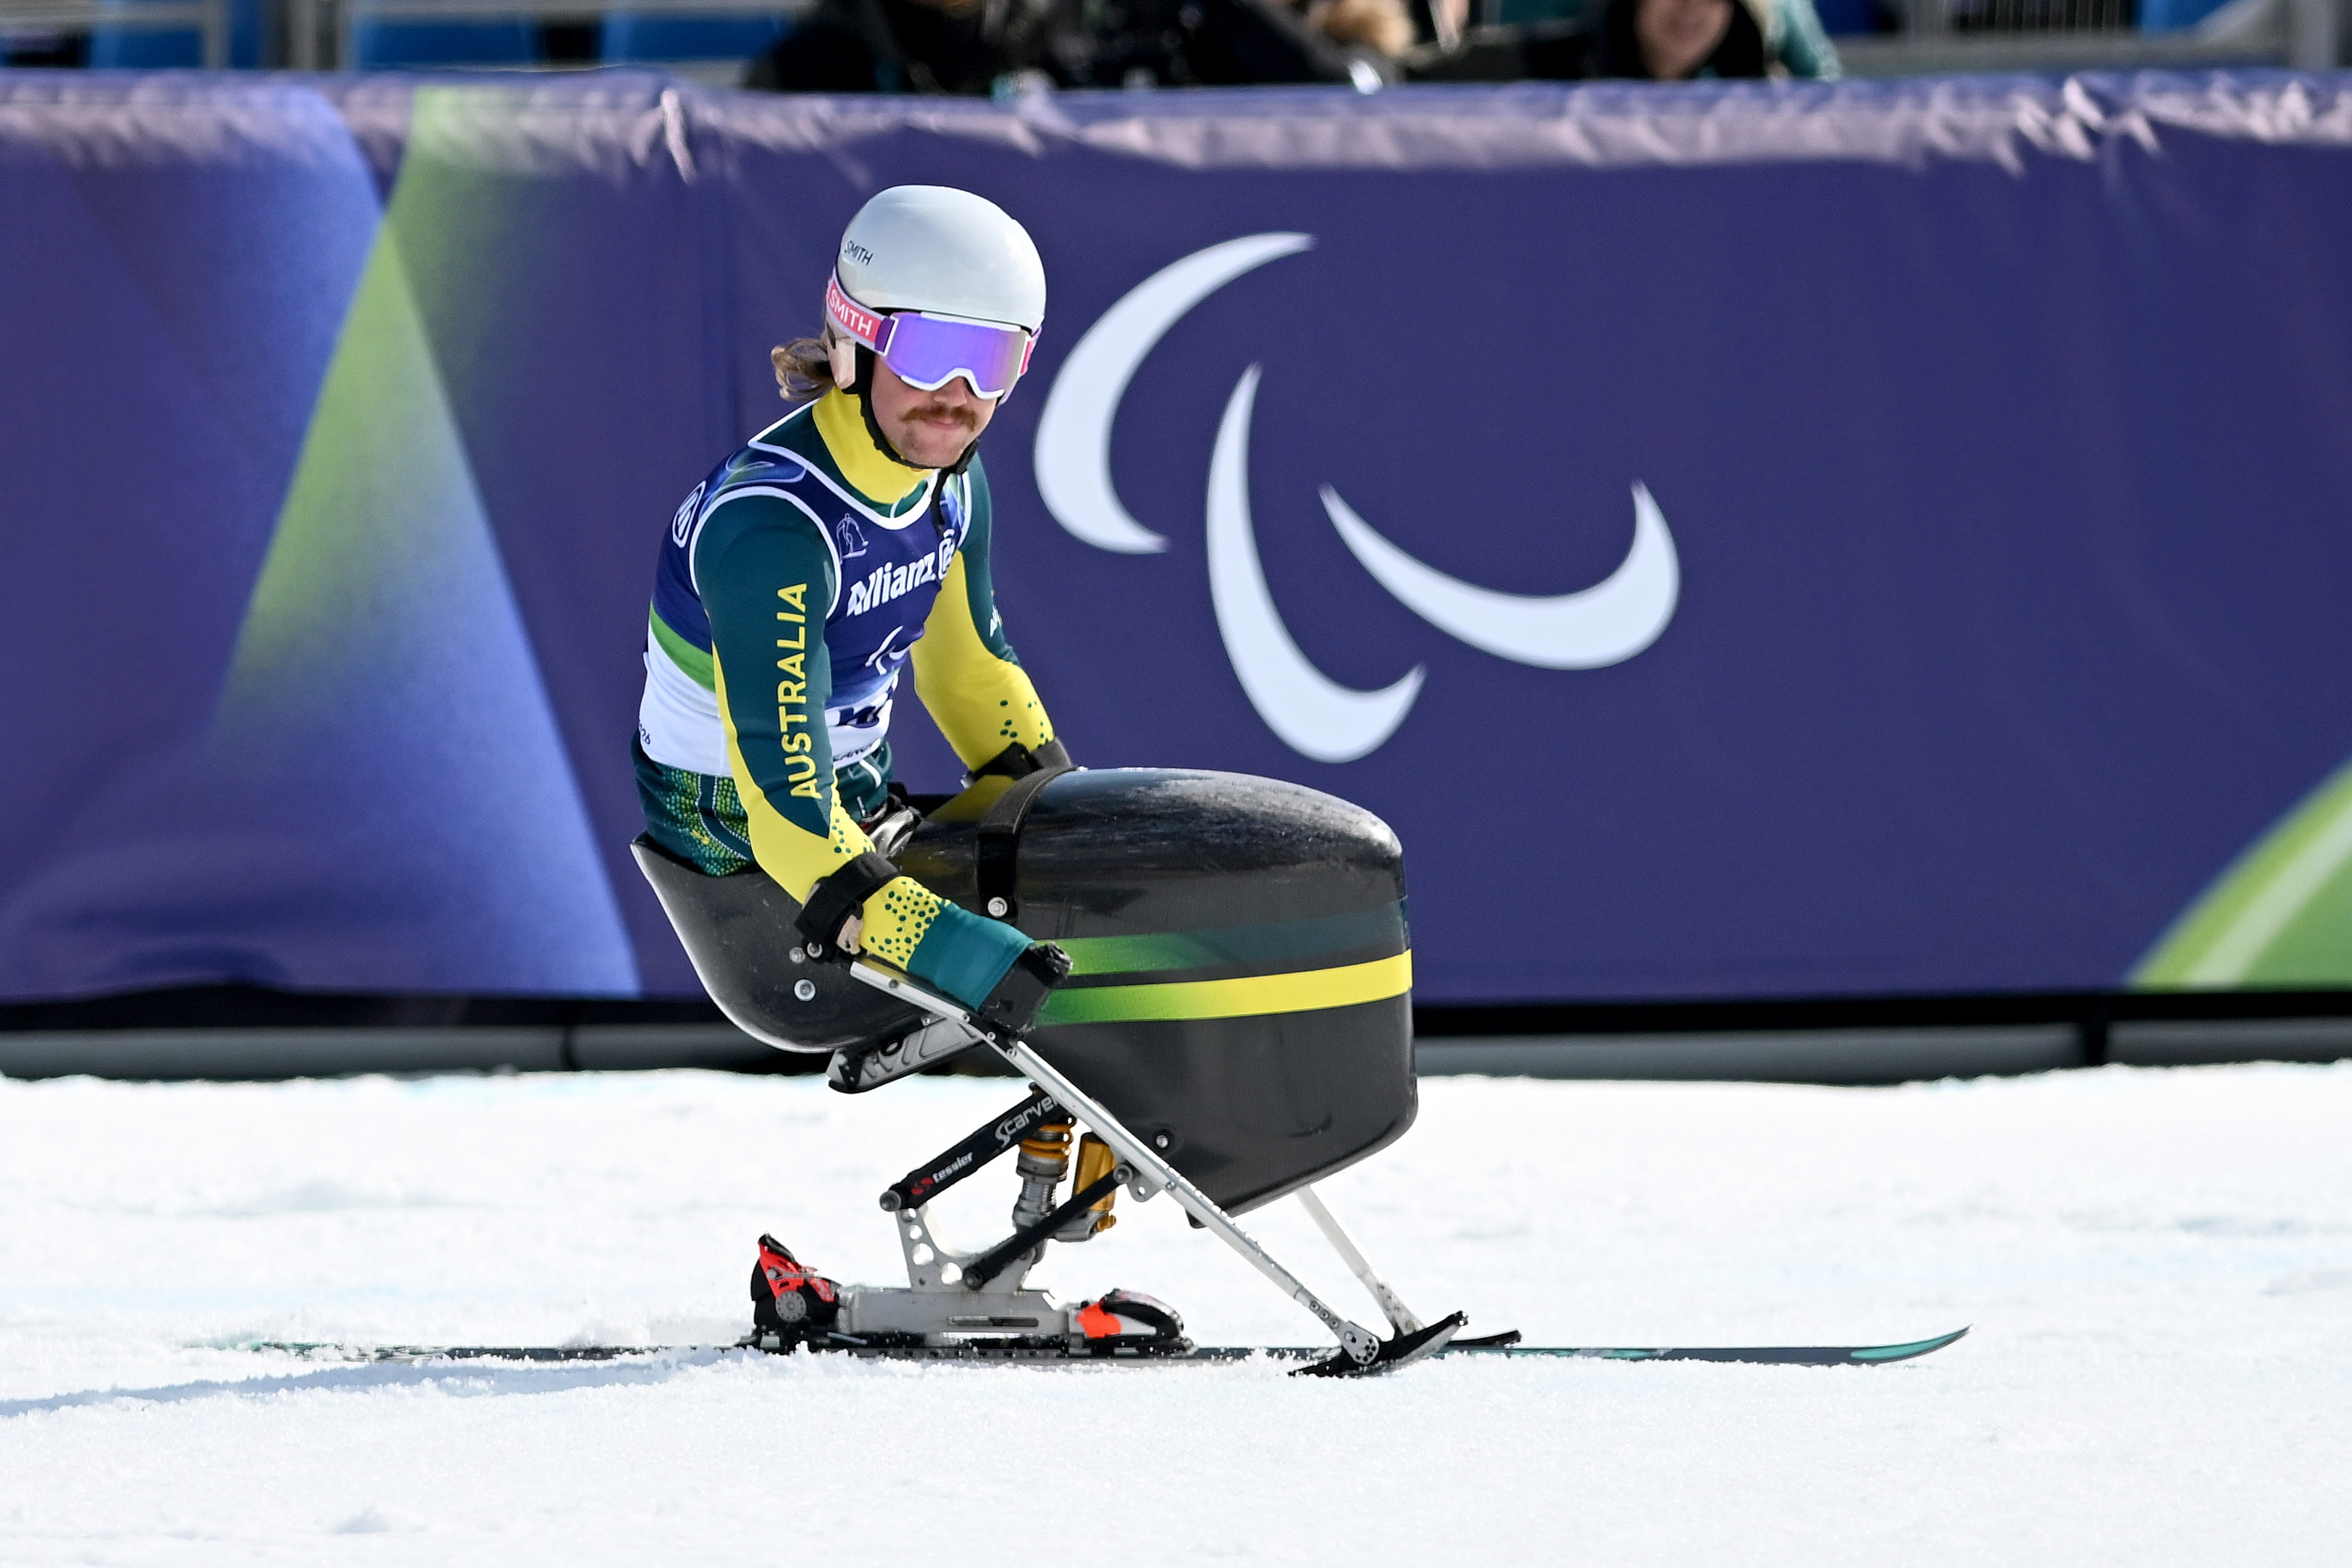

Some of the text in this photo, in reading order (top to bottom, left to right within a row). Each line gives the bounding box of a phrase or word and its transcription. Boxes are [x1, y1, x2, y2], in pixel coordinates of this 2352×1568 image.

[844, 240, 874, 266] SMITH
[829, 289, 873, 336] SMITH
[846, 551, 937, 617] Allianz
[777, 583, 822, 800] AUSTRALIA
[932, 1152, 973, 1183] tessler
